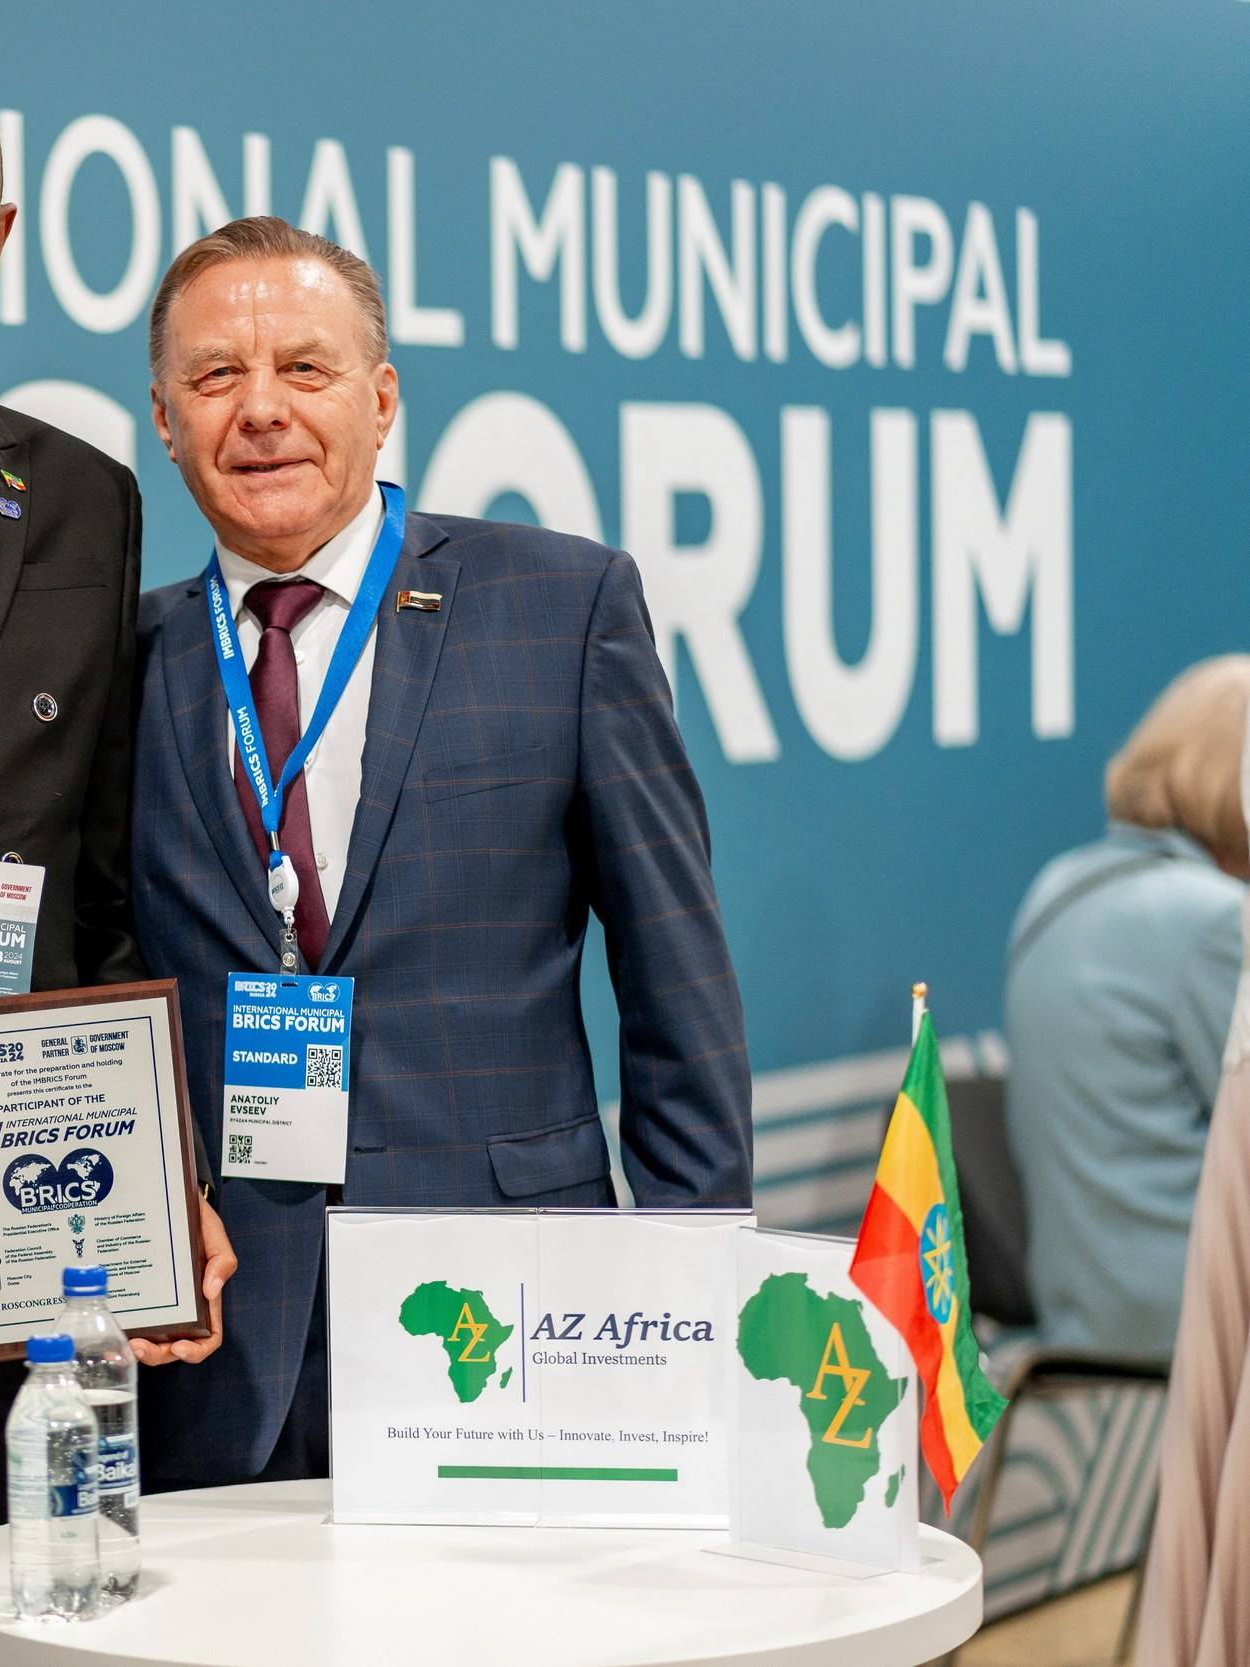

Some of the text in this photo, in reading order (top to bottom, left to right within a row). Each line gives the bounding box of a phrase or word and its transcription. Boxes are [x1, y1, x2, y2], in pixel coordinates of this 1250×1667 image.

[488, 155, 1073, 377] MUNICIPAL
[388, 391, 1076, 763] RUM
[216, 612, 235, 660] IMBRICS
[237, 706, 269, 808] IMBRICS FORUM
[0, 883, 33, 894] GOVERNMENT
[6, 893, 28, 901] MOSCOW
[3, 951, 23, 960] 2024
[233, 1004, 345, 1018] INTERNATIONAL MUNICIPAL
[232, 1013, 345, 1033] BRICS FORUM
[41, 1037, 69, 1048] GENERAL
[89, 1030, 129, 1043] GOVERNMENT
[42, 1048, 70, 1058] PARTNER
[90, 1042, 125, 1053] OF MOSCOW
[232, 1050, 299, 1065] STANDARD
[25, 1067, 38, 1075] the
[38, 1062, 80, 1074] preparation
[81, 1061, 95, 1069] and
[96, 1058, 123, 1067] holding
[33, 1075, 63, 1085] IMBRICS
[64, 1073, 87, 1081] Forum
[7, 1089, 32, 1097] presents
[45, 1085, 74, 1093] certificate
[67, 1096, 82, 1106] OF
[84, 1093, 106, 1104] THE
[230, 1094, 280, 1106] ANATOLIY
[5, 1106, 138, 1129] INTERNATIONAL MUNICIPAL
[230, 1105, 267, 1116] EVSEEV
[0, 1127, 60, 1149] BRICS
[63, 1119, 136, 1142] FORUM
[21, 1180, 97, 1207] BRICS
[21, 1200, 98, 1214] MUNICIPAL COOPERATION
[1, 1297, 67, 1311] ROSCONGRESS
[530, 1311, 715, 1349] AZ Africa
[532, 1351, 668, 1367] Global Investments
[386, 1426, 420, 1439] Build
[423, 1427, 453, 1440] Your
[455, 1427, 494, 1440] Future
[497, 1428, 525, 1441] with
[527, 1429, 545, 1441] Us
[618, 1430, 659, 1444] Invest,
[662, 1430, 709, 1445] Inspire!
